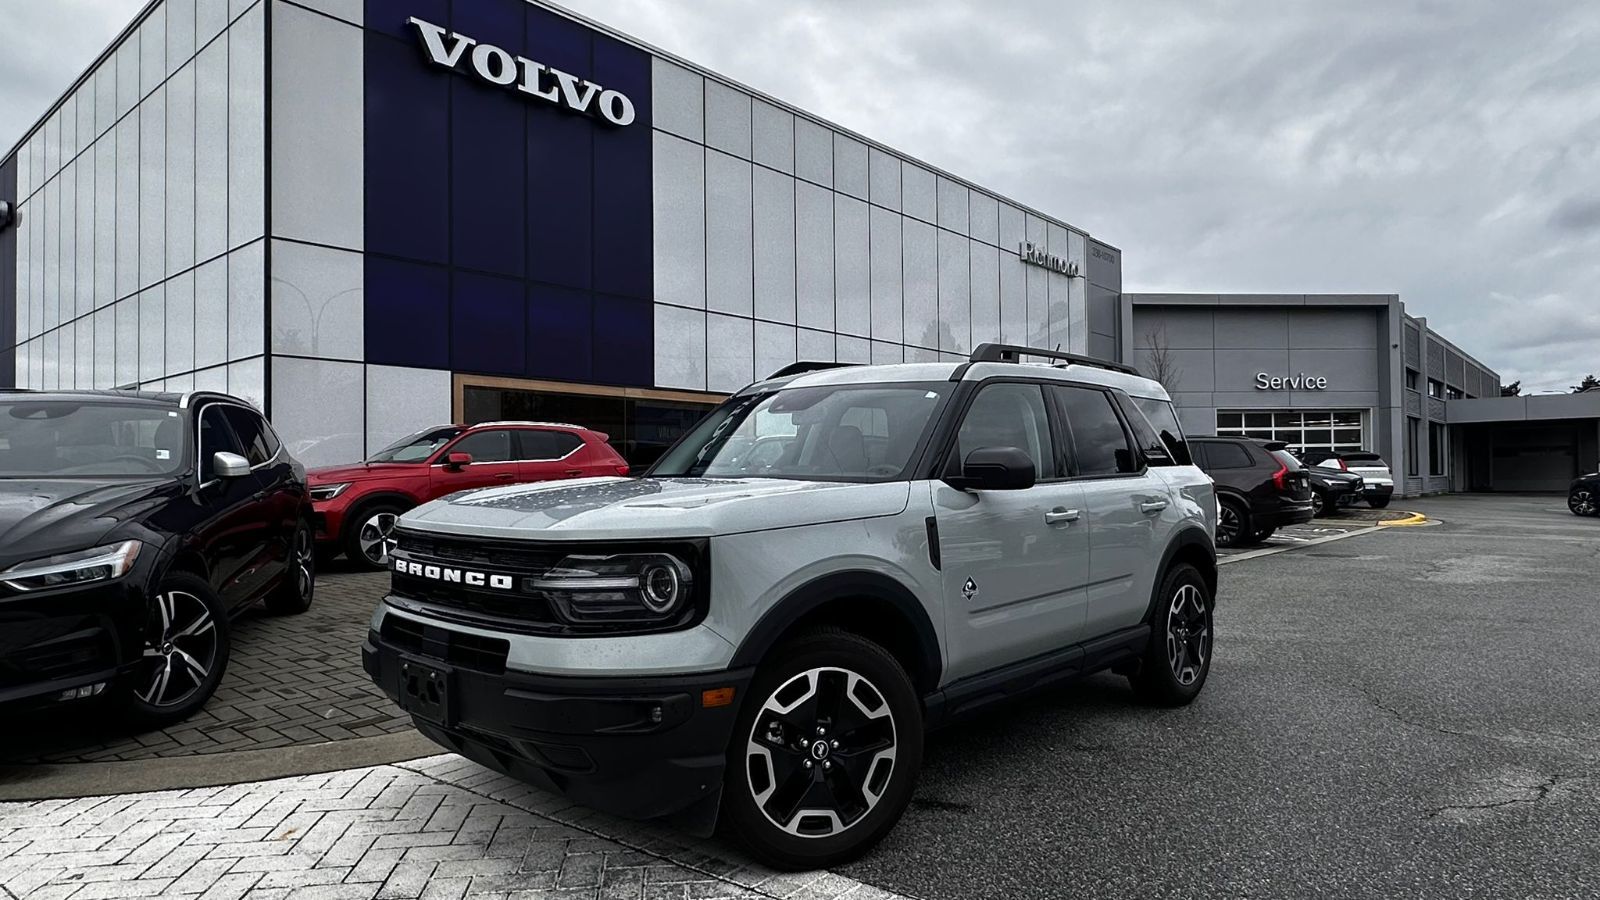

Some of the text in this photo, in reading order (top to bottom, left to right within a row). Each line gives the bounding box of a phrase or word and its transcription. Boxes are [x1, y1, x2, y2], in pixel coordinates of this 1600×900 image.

[407, 16, 636, 126] VOLVO
[1020, 240, 1080, 277] Richmond
[1255, 372, 1328, 390] Service
[395, 559, 513, 589] BRONCO
